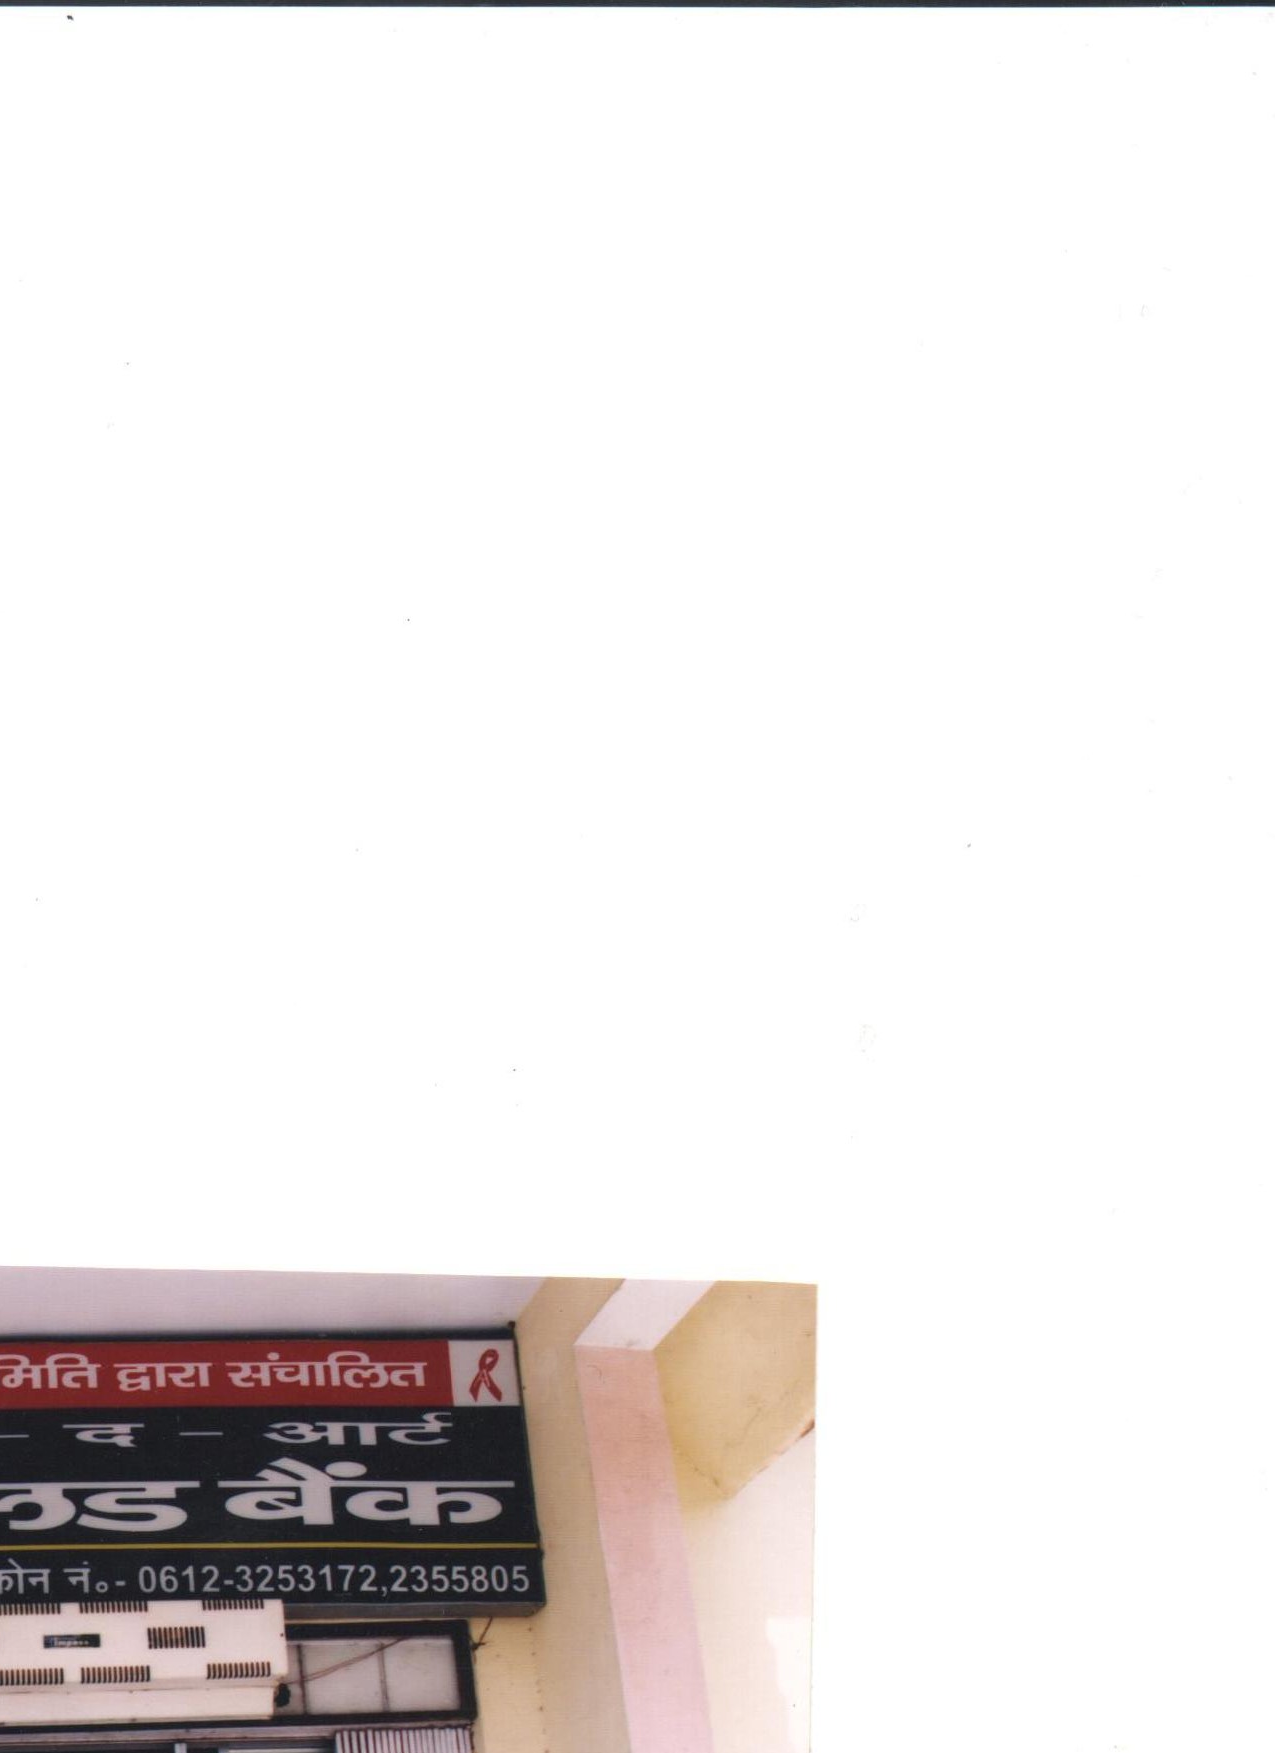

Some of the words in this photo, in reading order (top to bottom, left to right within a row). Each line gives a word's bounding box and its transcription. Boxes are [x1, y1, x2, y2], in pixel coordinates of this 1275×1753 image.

[116, 1364, 212, 1392] द्वारा
[228, 1351, 427, 1389] संचालित
[63, 1424, 144, 1448] द
[263, 1412, 453, 1446] आर्ट
[218, 1457, 515, 1526] बैंक
